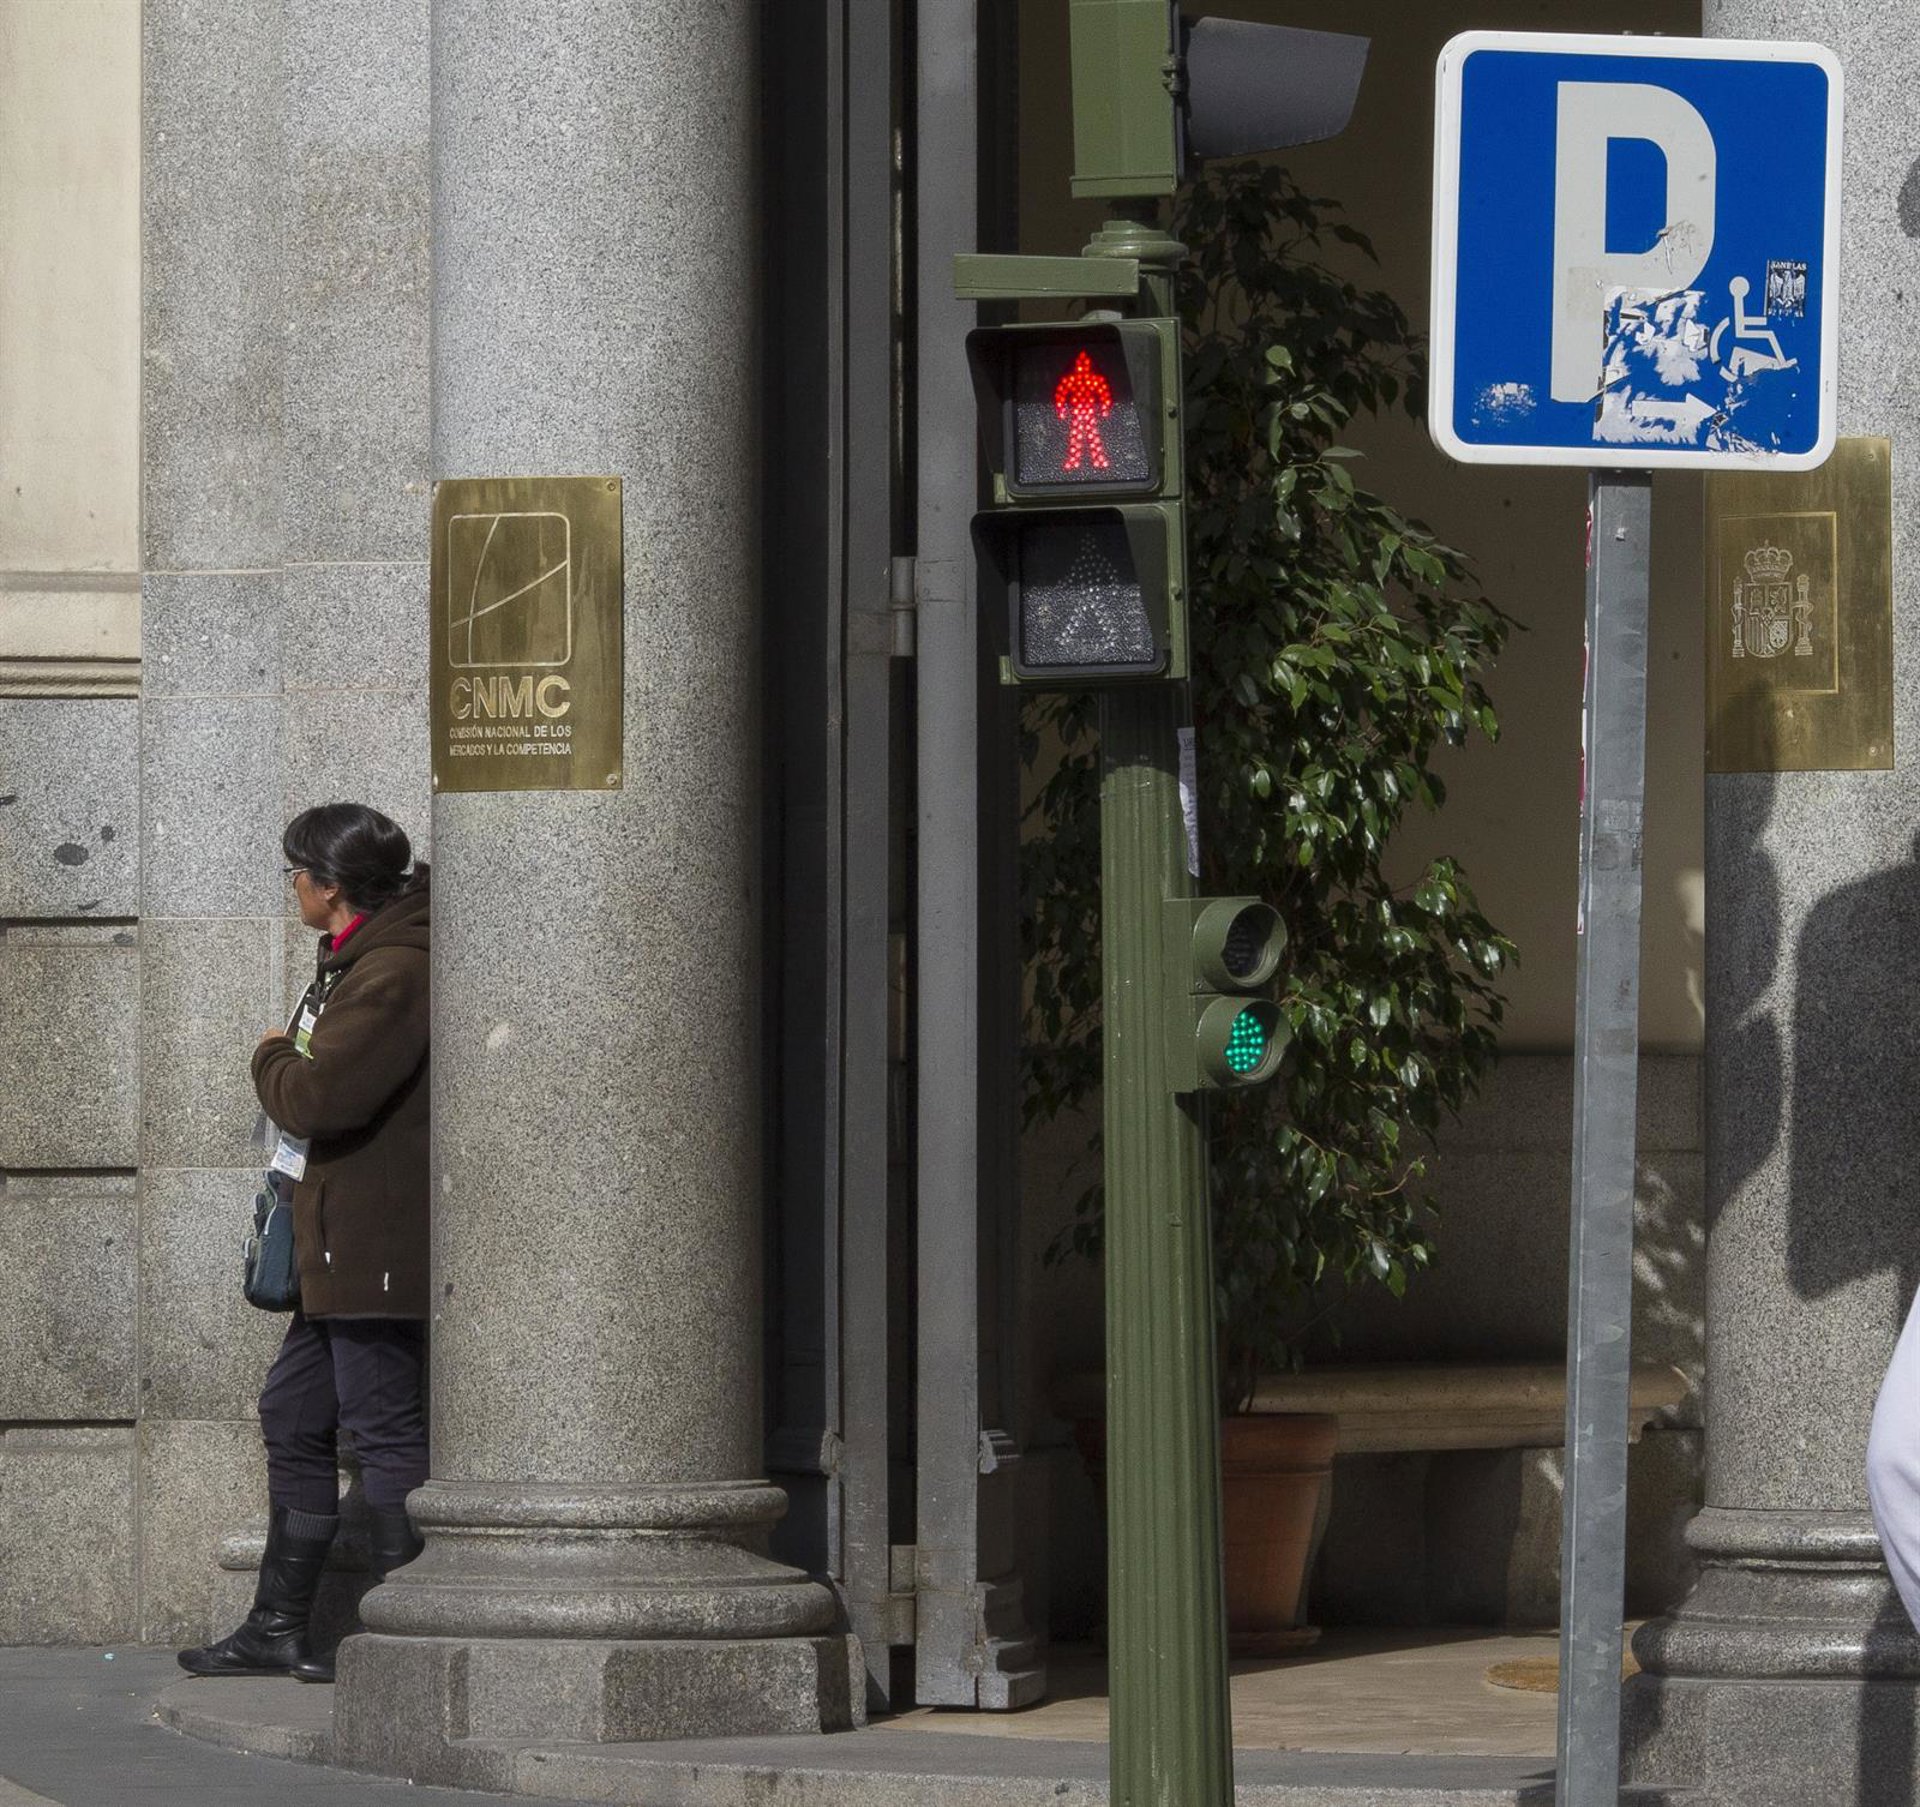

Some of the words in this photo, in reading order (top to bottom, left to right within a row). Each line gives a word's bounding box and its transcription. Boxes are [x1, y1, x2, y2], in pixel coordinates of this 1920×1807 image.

[1551, 81, 1717, 403] P
[450, 675, 571, 720] CNMC
[484, 726, 531, 738] NACIONAL
[533, 725, 548, 737] DE
[550, 725, 572, 738] LOS
[449, 744, 485, 757] MERCADOS
[486, 744, 494, 756] Y
[494, 743, 505, 756] LA
[506, 742, 572, 756] COMPETENCIA
